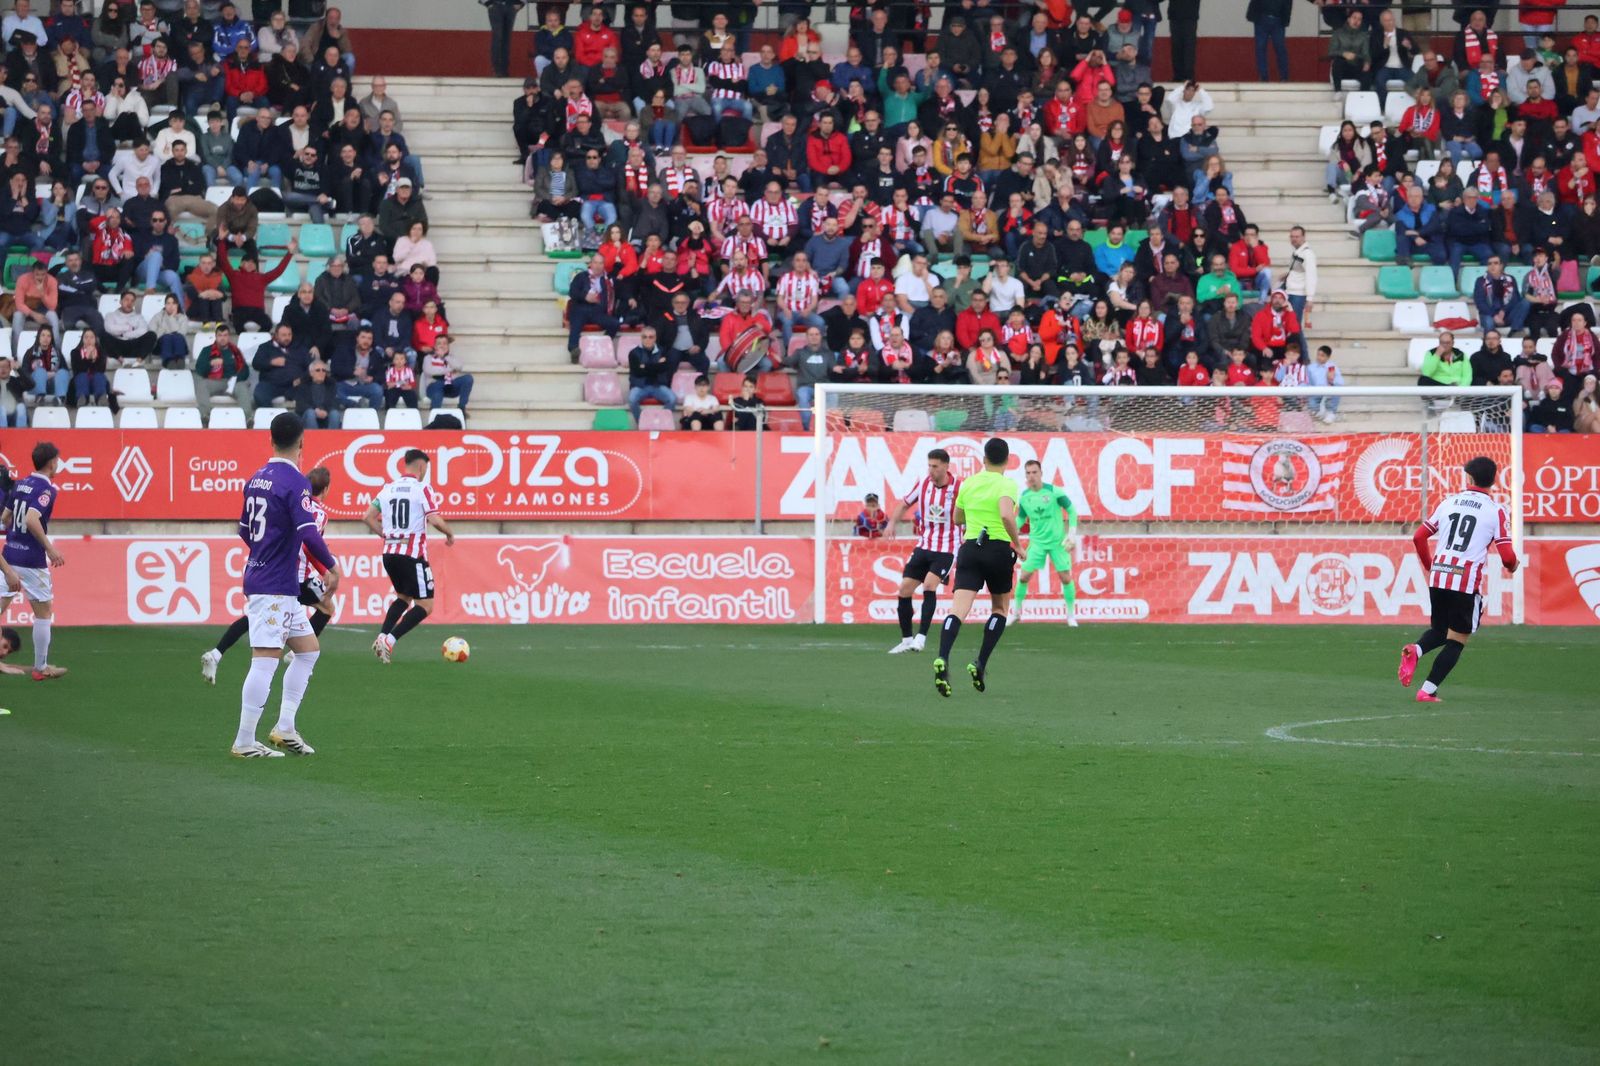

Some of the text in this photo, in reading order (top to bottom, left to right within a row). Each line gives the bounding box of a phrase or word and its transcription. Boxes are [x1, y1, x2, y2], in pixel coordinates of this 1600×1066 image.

[189, 457, 238, 475] Grupo
[780, 436, 1206, 517] ZAMORA CF
[1378, 464, 1527, 491] CENTO
[56, 482, 94, 491] ACIA
[190, 475, 246, 492] Leom
[487, 493, 496, 505] Y
[504, 492, 610, 506] JAMONES
[12, 499, 28, 534] 14
[246, 496, 268, 542] 23
[389, 498, 410, 529] 10
[1446, 512, 1477, 552] 19
[603, 546, 795, 580] Escuela
[1188, 552, 1432, 616] ZAMORA
